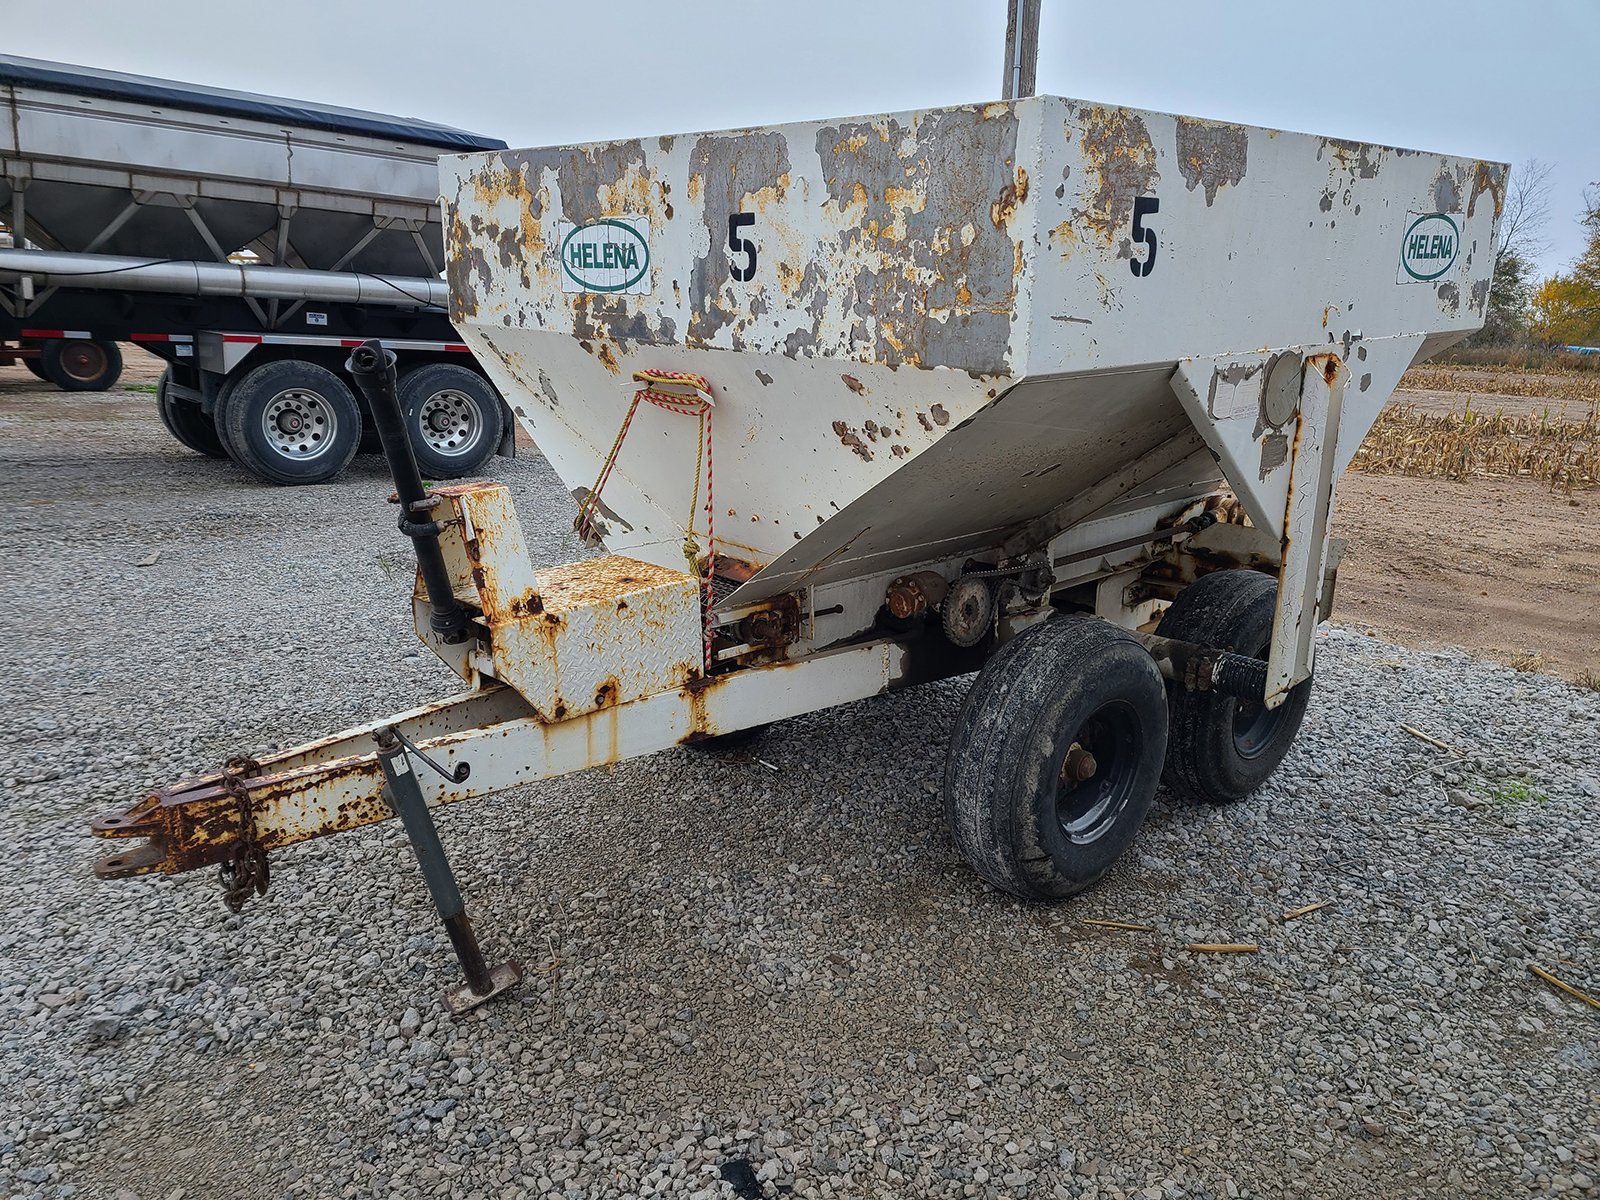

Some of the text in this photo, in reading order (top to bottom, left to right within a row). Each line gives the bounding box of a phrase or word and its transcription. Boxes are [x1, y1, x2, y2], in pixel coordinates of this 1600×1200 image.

[570, 243, 639, 269] HELENA
[729, 212, 757, 282] 5
[1130, 197, 1159, 277] 5
[1407, 234, 1452, 259] HELENA
